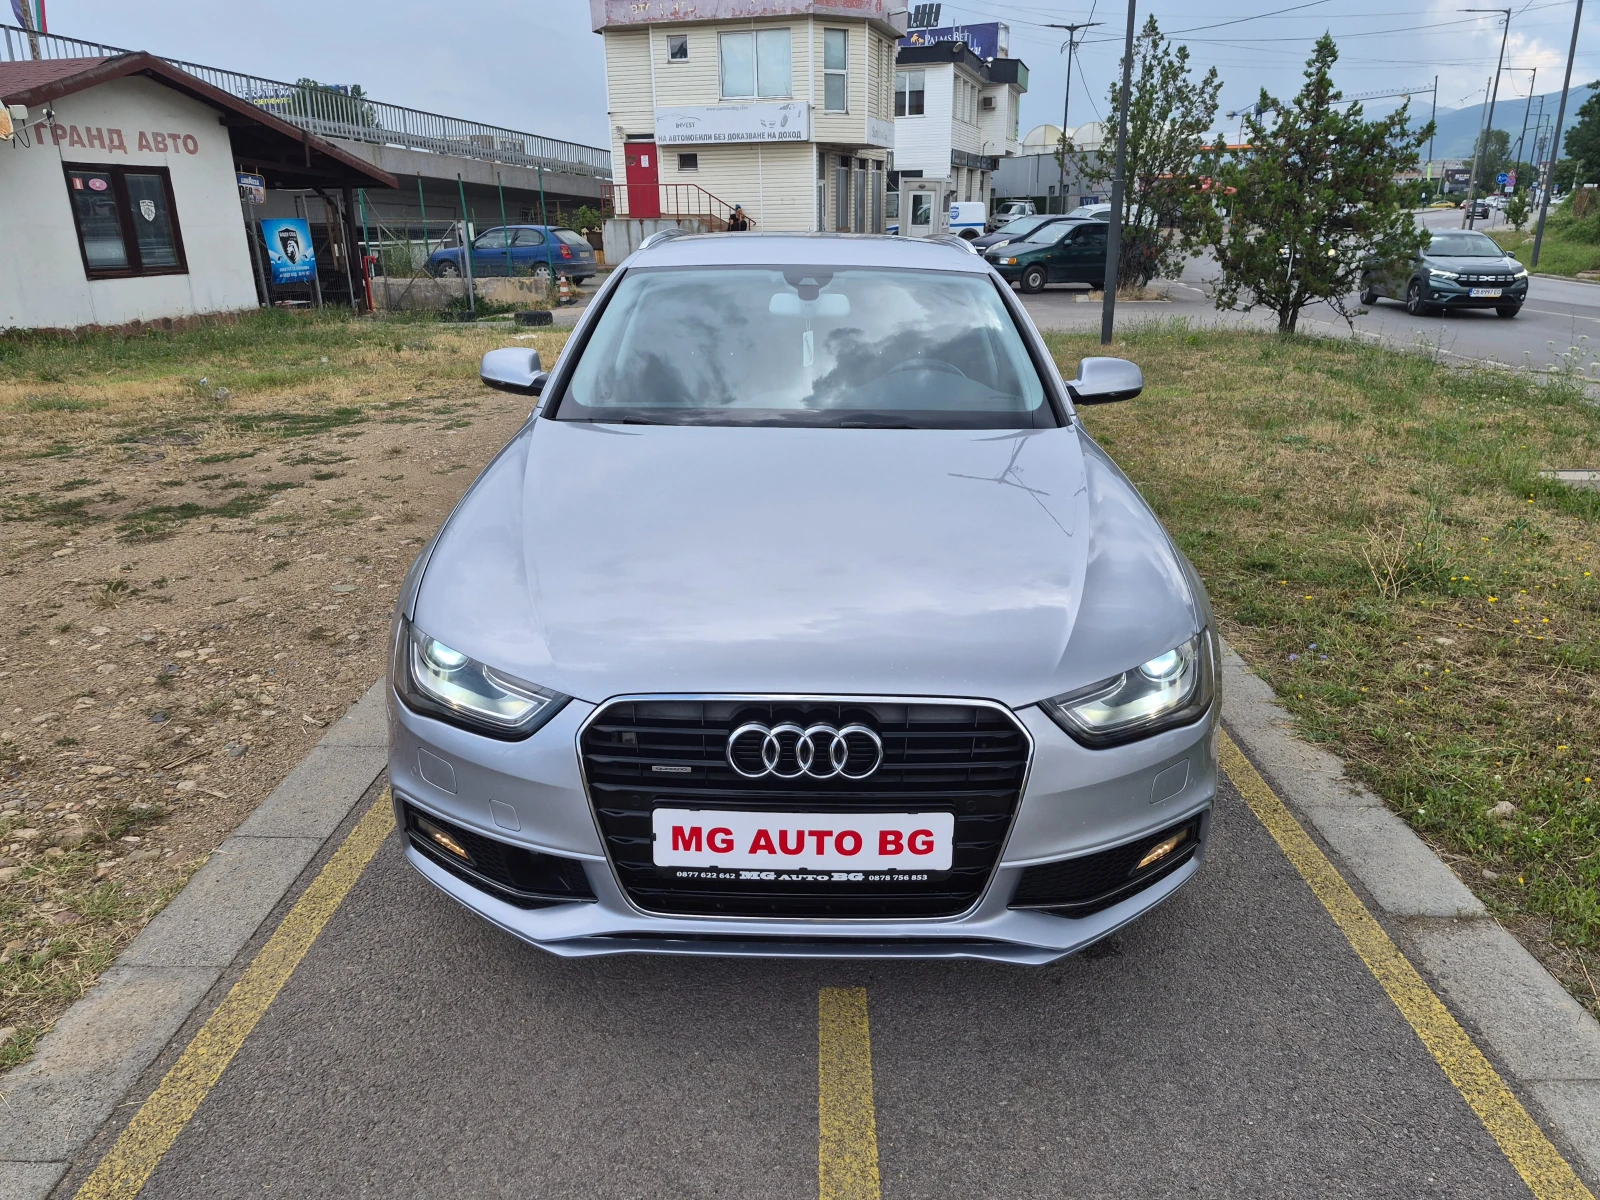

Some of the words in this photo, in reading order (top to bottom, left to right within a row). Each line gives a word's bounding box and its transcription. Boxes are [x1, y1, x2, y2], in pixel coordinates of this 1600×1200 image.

[33, 121, 128, 155] ГРАНД
[137, 130, 199, 156] АВТО
[657, 135, 667, 143] НА
[668, 134, 713, 142] АВТОМОБИЛИ
[713, 133, 726, 141] БЕЗ
[727, 132, 766, 141] ДОКАЗВАНЕ
[767, 131, 777, 139] НА
[777, 130, 802, 140] ДОХОД
[672, 825, 735, 854] MG
[748, 828, 863, 856] AUTO
[878, 829, 935, 855] BG
[739, 870, 777, 880] MG
[830, 872, 865, 881] BG
